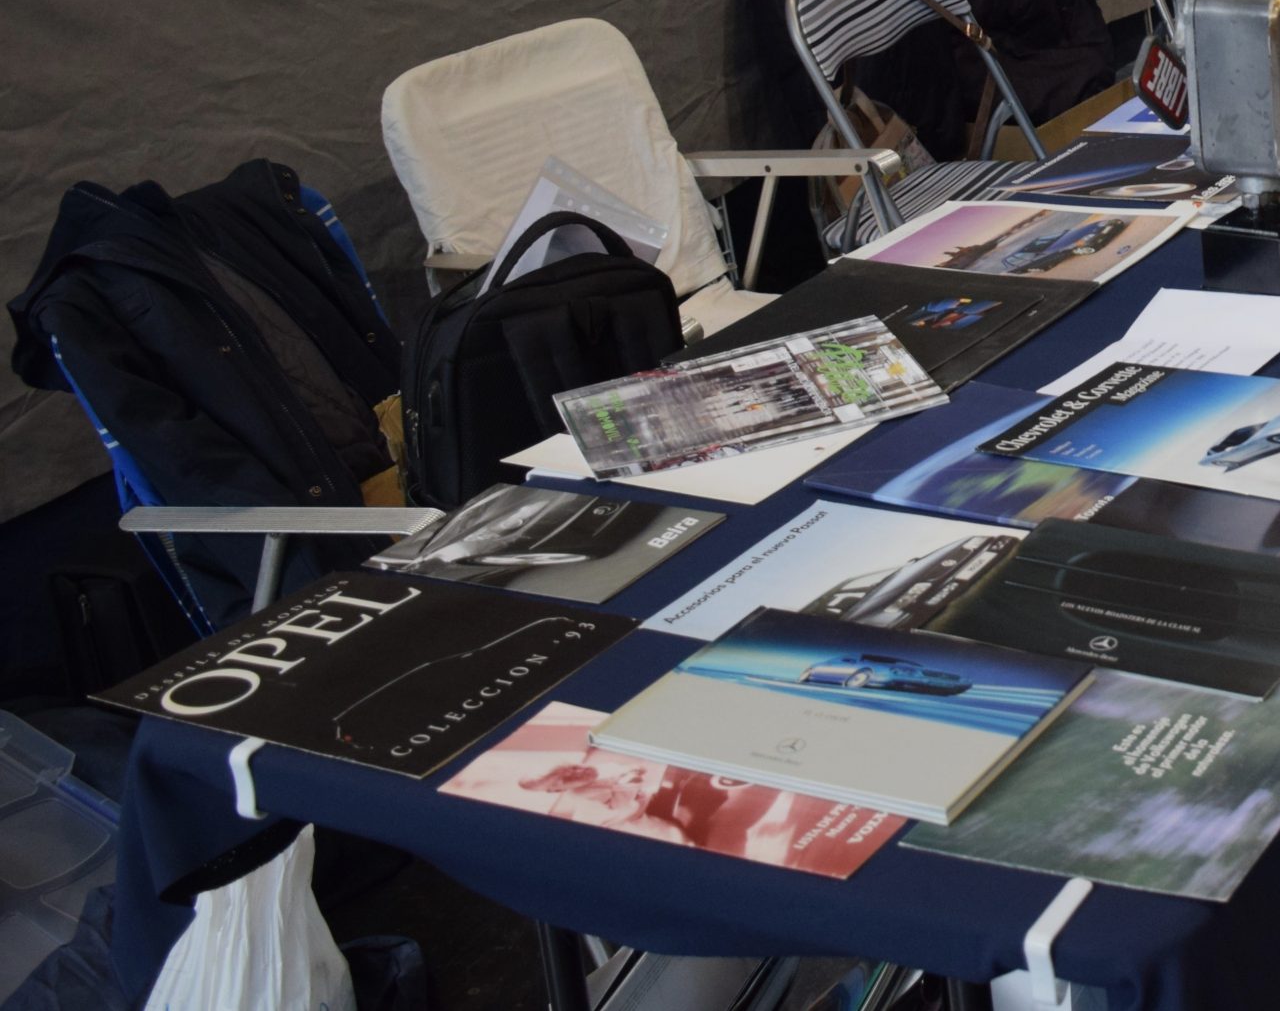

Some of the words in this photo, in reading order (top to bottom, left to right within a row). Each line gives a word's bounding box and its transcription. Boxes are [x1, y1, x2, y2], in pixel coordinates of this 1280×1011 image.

[995, 409, 1075, 452] Chevrolet
[1062, 399, 1090, 411] &
[1077, 365, 1142, 401] Corvette
[1110, 370, 1166, 402] Magazine
[663, 583, 727, 625] Accesorios
[724, 564, 753, 585] para
[751, 556, 763, 565] el
[761, 533, 797, 557] nuevo
[789, 510, 829, 535] Passat
[134, 650, 221, 701] DESFILE
[227, 633, 256, 647] DE
[261, 580, 350, 629] MODELOS
[160, 587, 423, 716] OPEL
[390, 653, 549, 757] COLECCION
[1126, 717, 1171, 758] homenaje
[1140, 713, 1193, 763] Volkswagen
[1132, 763, 1151, 776] de
[1159, 740, 1189, 769] primer
